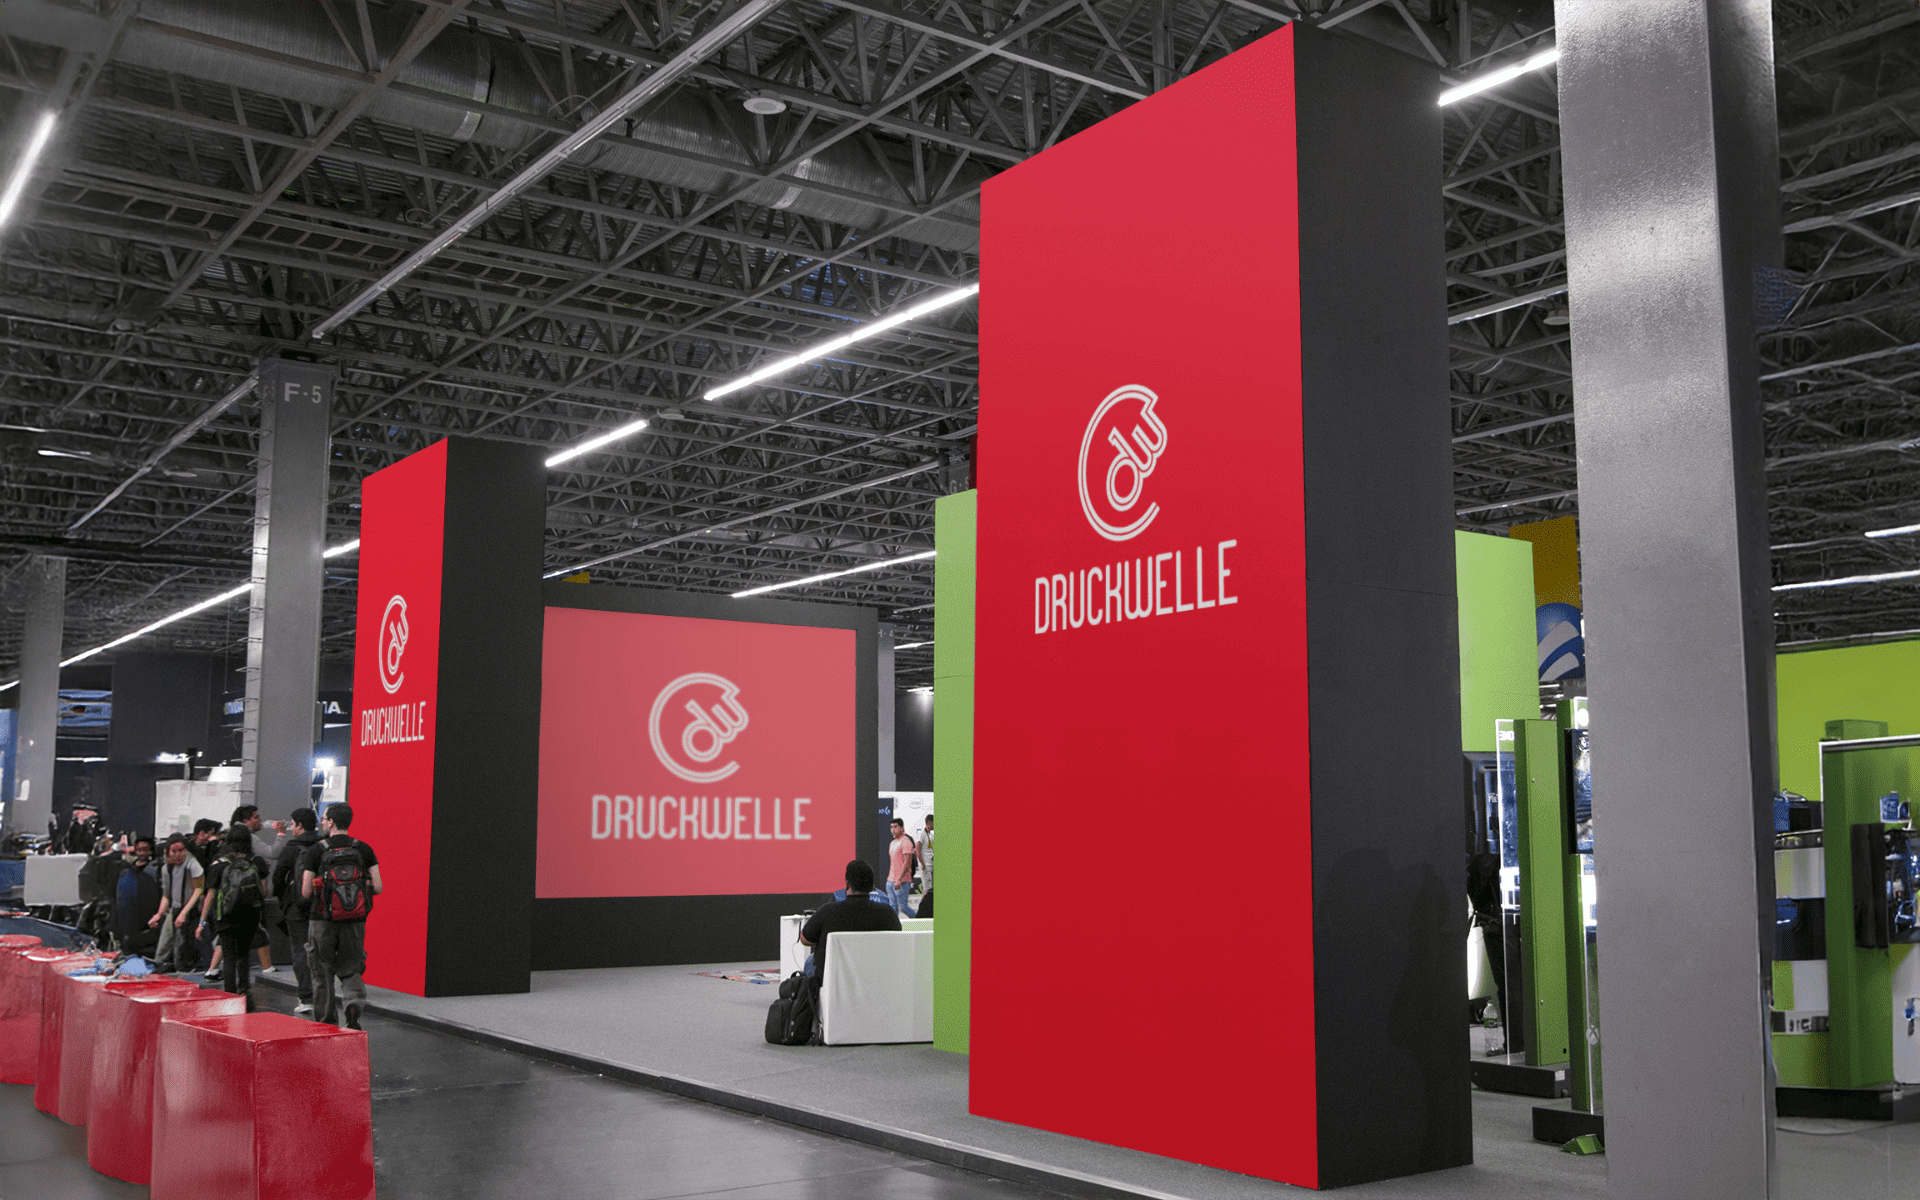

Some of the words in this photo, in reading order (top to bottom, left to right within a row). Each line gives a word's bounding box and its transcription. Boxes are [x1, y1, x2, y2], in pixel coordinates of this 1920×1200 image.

[1035, 539, 1238, 634] DRUCKWELLE
[361, 701, 426, 746] DRUCKWELLE
[592, 794, 811, 840] DRUCKWELLE
